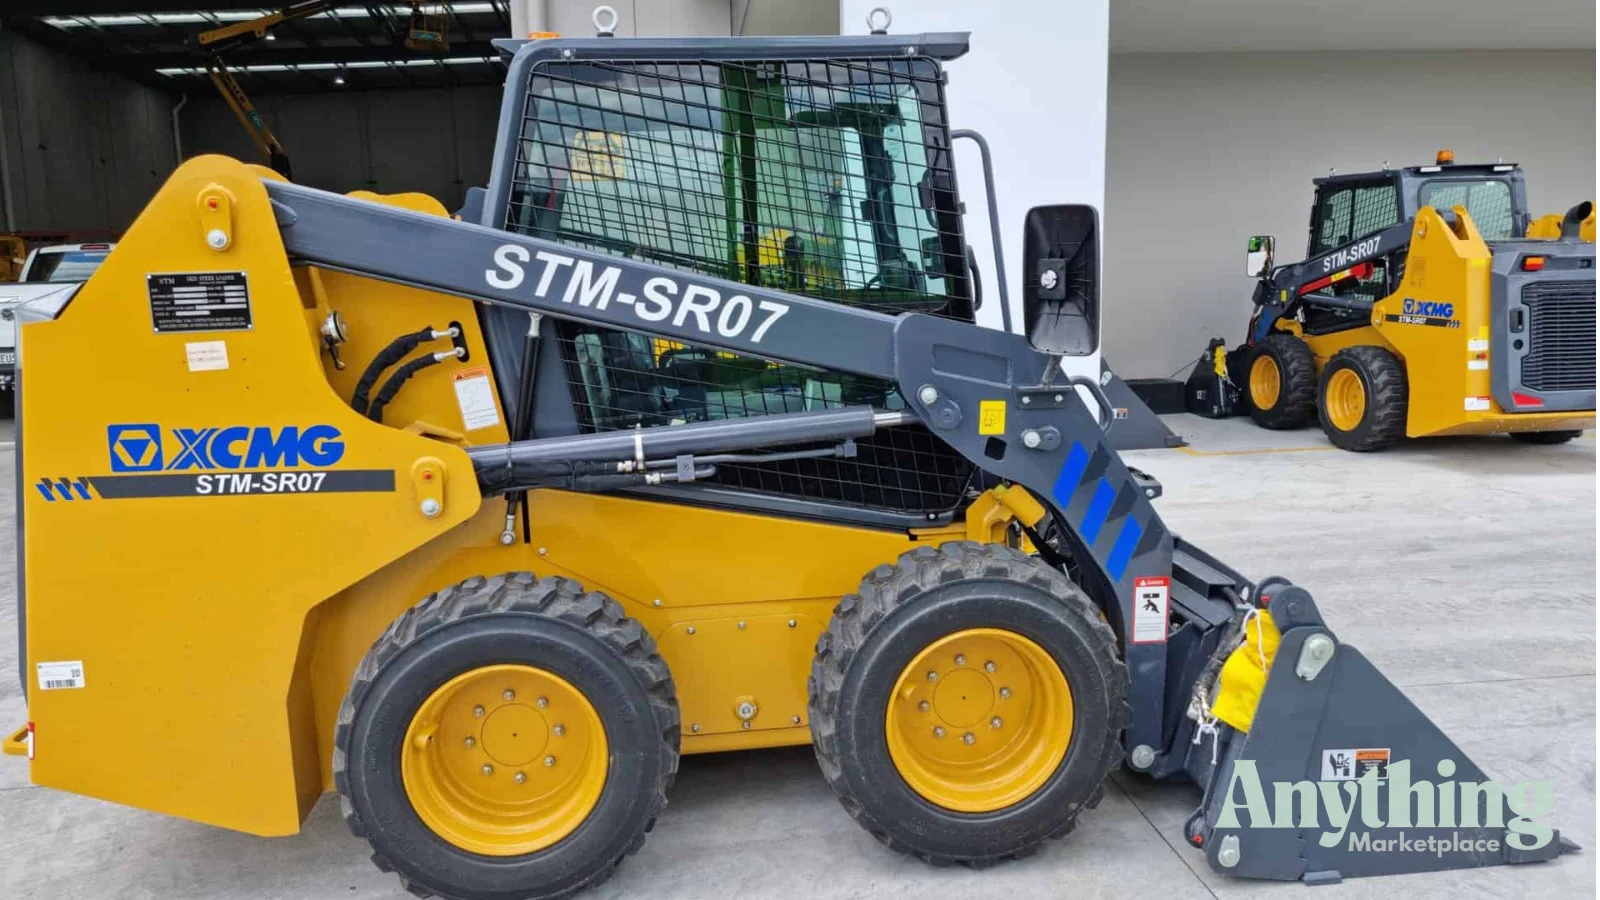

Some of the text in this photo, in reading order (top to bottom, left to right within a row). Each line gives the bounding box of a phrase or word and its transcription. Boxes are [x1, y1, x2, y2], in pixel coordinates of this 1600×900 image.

[1323, 236, 1381, 272] STM-SR07
[485, 244, 789, 343] STM-SR07
[1398, 316, 1427, 325] STM-SR07
[1415, 301, 1454, 318] XCMG
[165, 424, 345, 470] XCMG
[196, 472, 327, 494] STM-SR07
